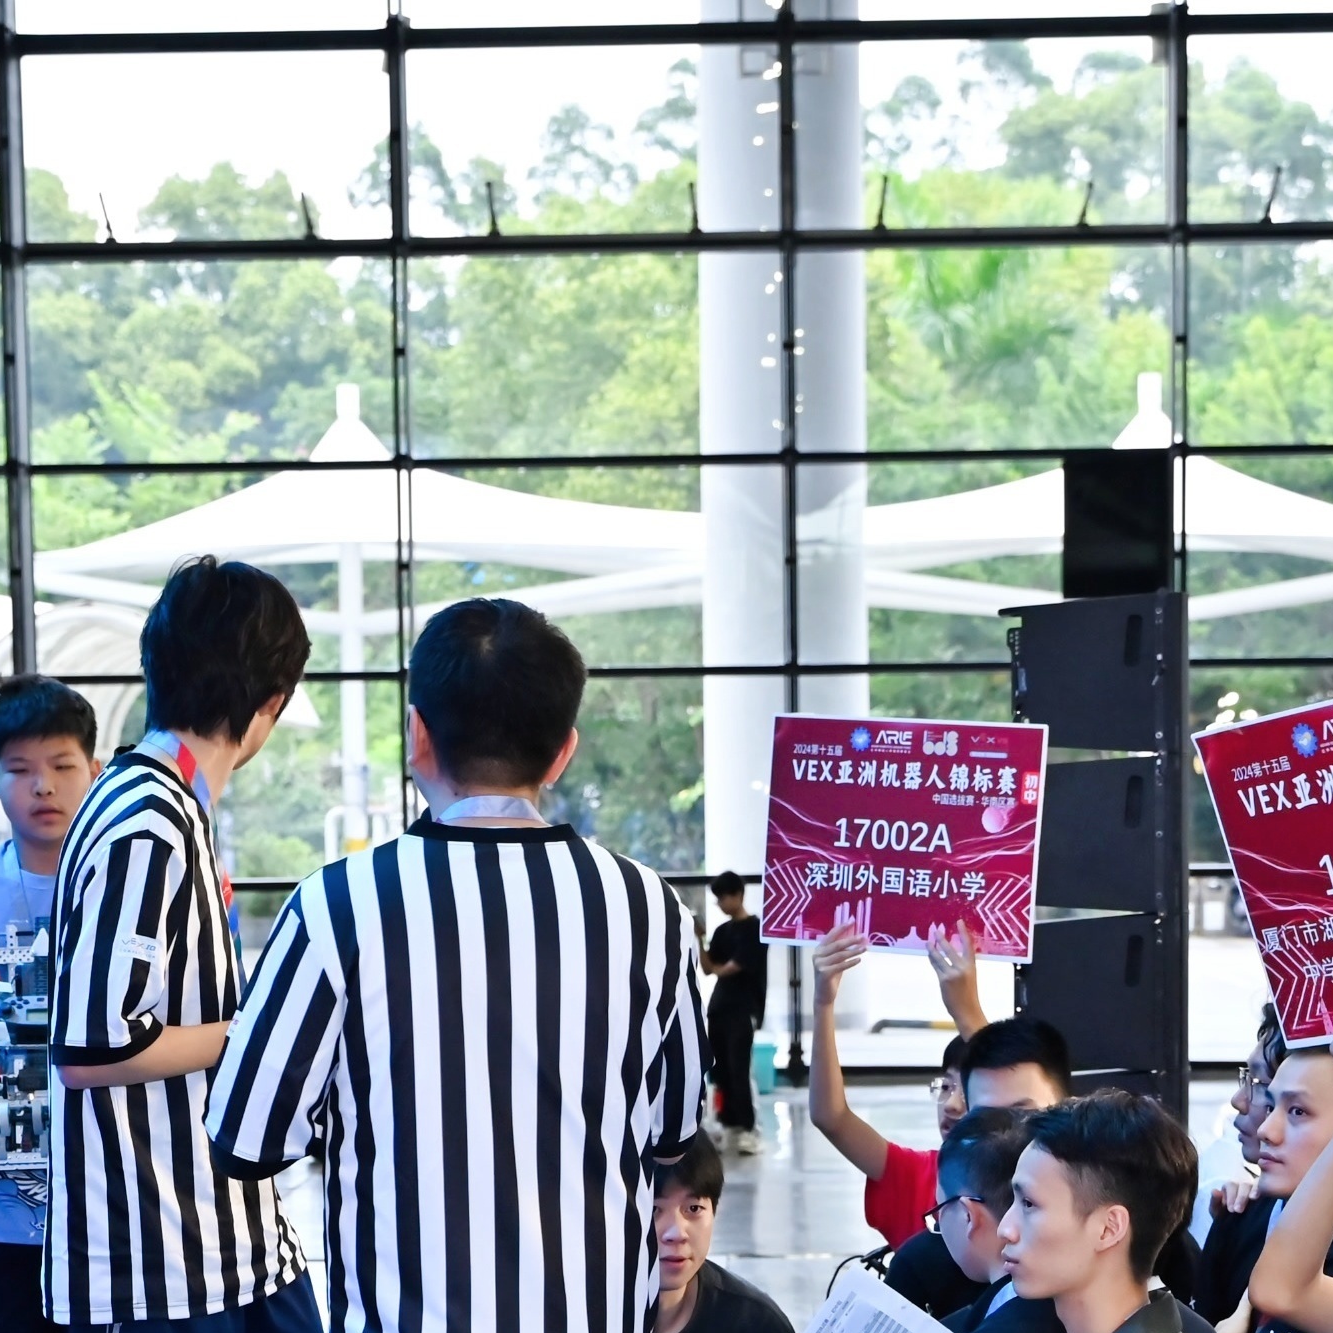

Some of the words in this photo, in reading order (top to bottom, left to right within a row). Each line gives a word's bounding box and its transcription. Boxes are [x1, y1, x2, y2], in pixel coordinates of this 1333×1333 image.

[793, 743, 844, 757] 2024第十五届
[792, 758, 1018, 796] VEX亚洲机器人锦标赛
[1231, 755, 1292, 783] 2024第十五届
[1024, 773, 1039, 805] 初中
[833, 817, 953, 854] 17002A
[805, 862, 986, 901] 深圳外国语小学
